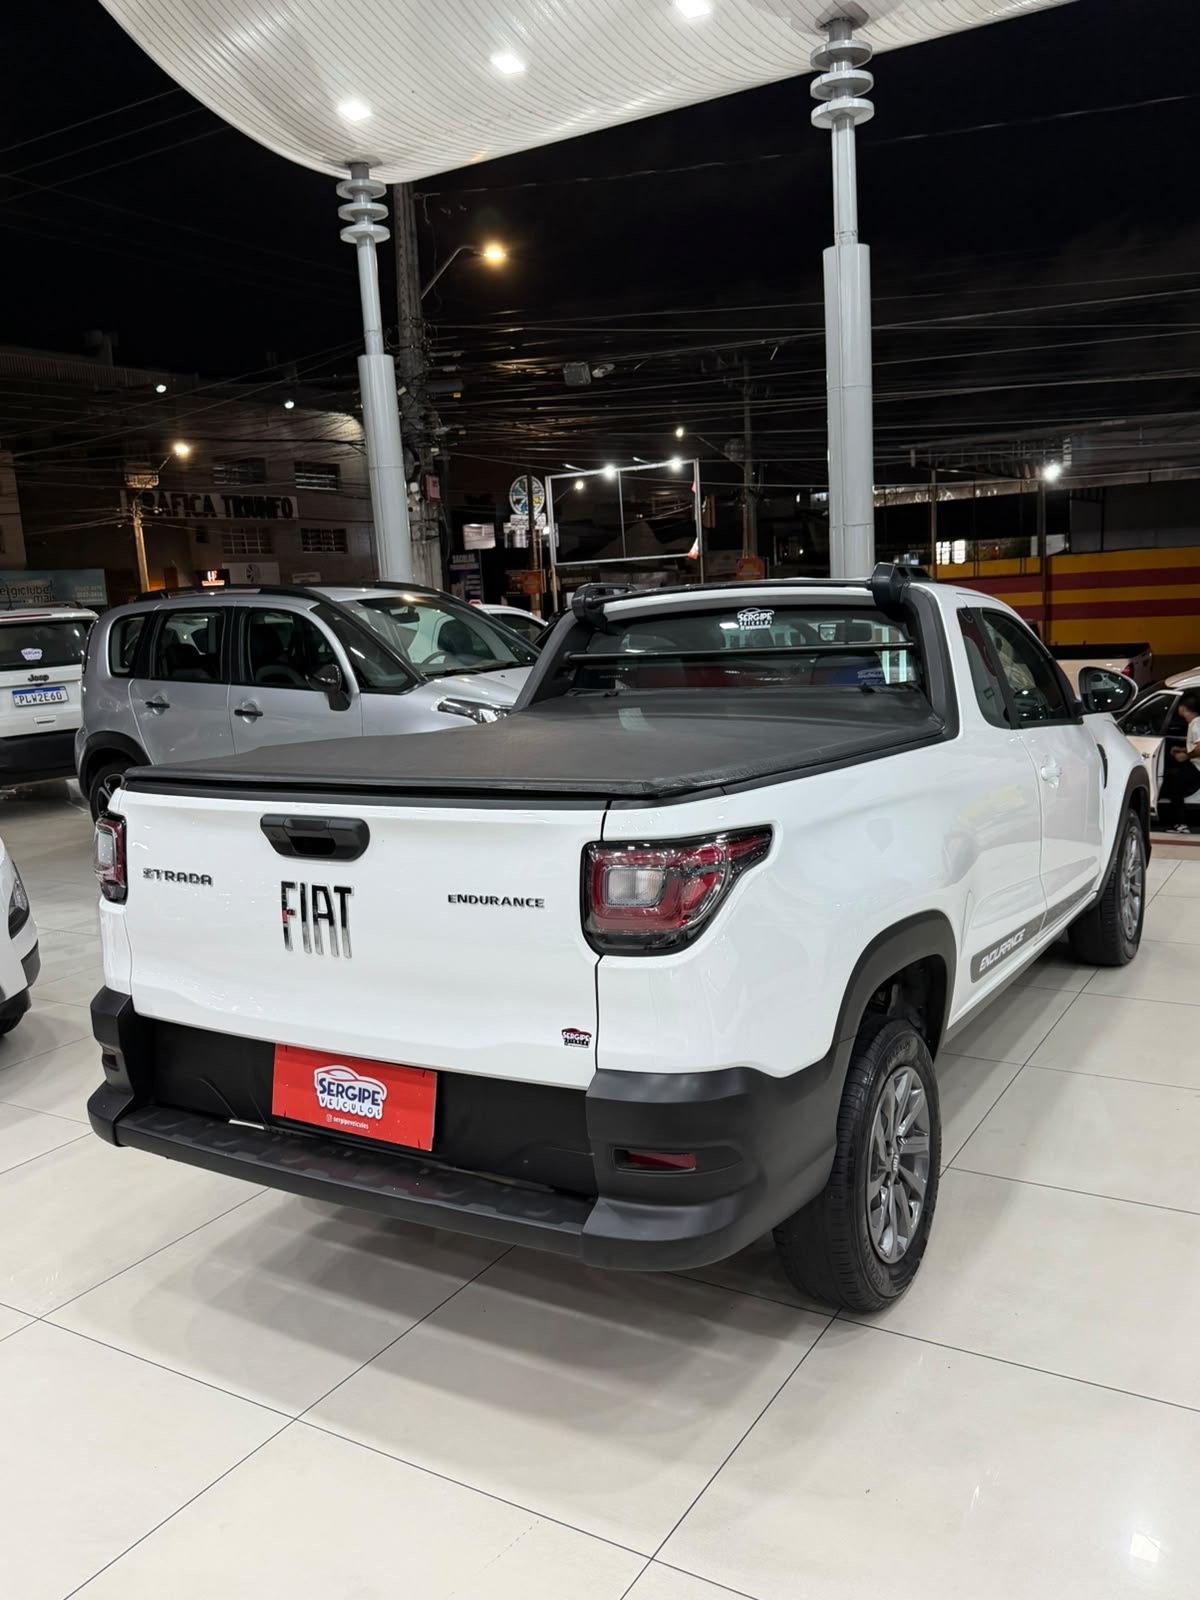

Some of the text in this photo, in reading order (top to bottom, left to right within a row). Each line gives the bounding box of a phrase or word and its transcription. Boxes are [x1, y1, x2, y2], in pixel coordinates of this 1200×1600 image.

[27, 673, 50, 682] Jeep
[142, 867, 214, 887] STRADA
[447, 893, 545, 909] ENDURANCE
[281, 880, 354, 959] FIAT
[979, 928, 1026, 973] ENDURANCE
[318, 1077, 381, 1107] SERGIPE
[320, 1096, 381, 1117] VEÍCULOS
